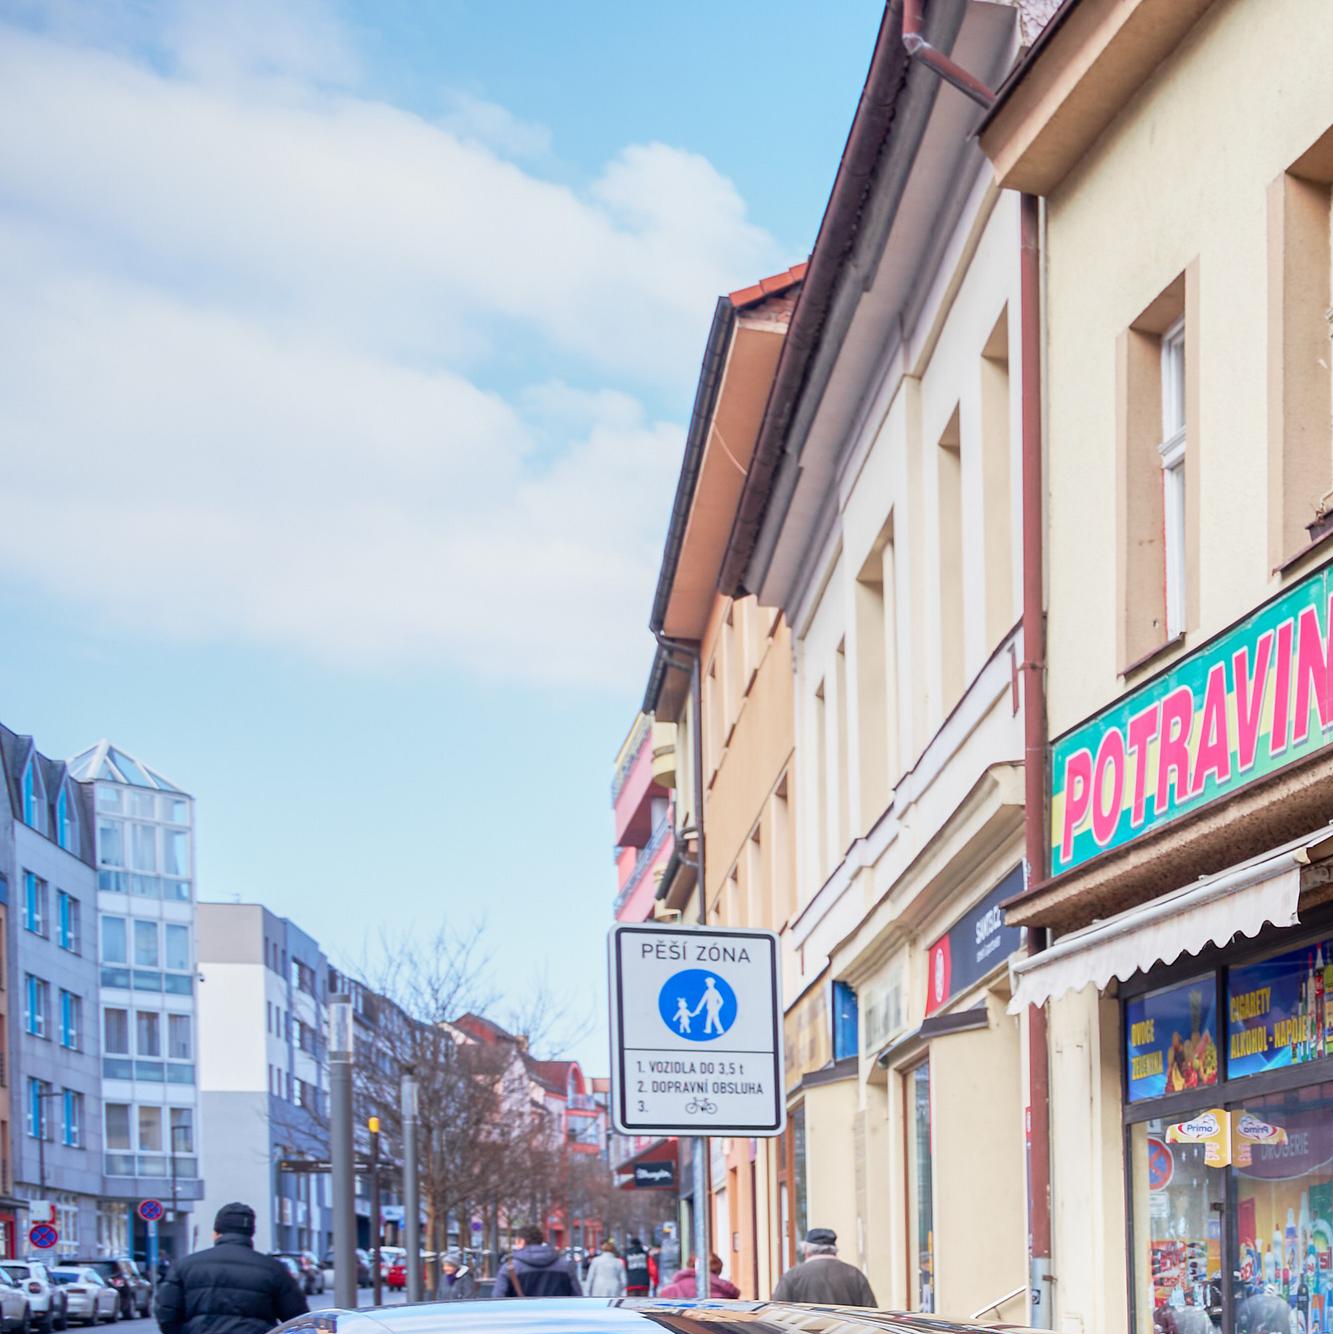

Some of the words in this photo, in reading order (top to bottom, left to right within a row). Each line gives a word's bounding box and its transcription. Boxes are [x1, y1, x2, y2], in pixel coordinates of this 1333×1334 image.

[641, 940, 687, 961] PĚŠÍ
[696, 942, 752, 963] ZÓNA
[1230, 986, 1272, 1023] CIGARETY
[1230, 1026, 1269, 1060] ALKOHOL
[637, 1061, 646, 1074] 1.
[649, 1061, 697, 1075] VOZIDLA
[700, 1062, 715, 1075] DO
[718, 1063, 736, 1076] 3,5
[739, 1064, 744, 1075] t
[637, 1080, 648, 1094] 2.
[651, 1079, 709, 1094] DOPRAVNÍ
[712, 1081, 764, 1094] OBSLUHA
[637, 1100, 649, 1113] 3.
